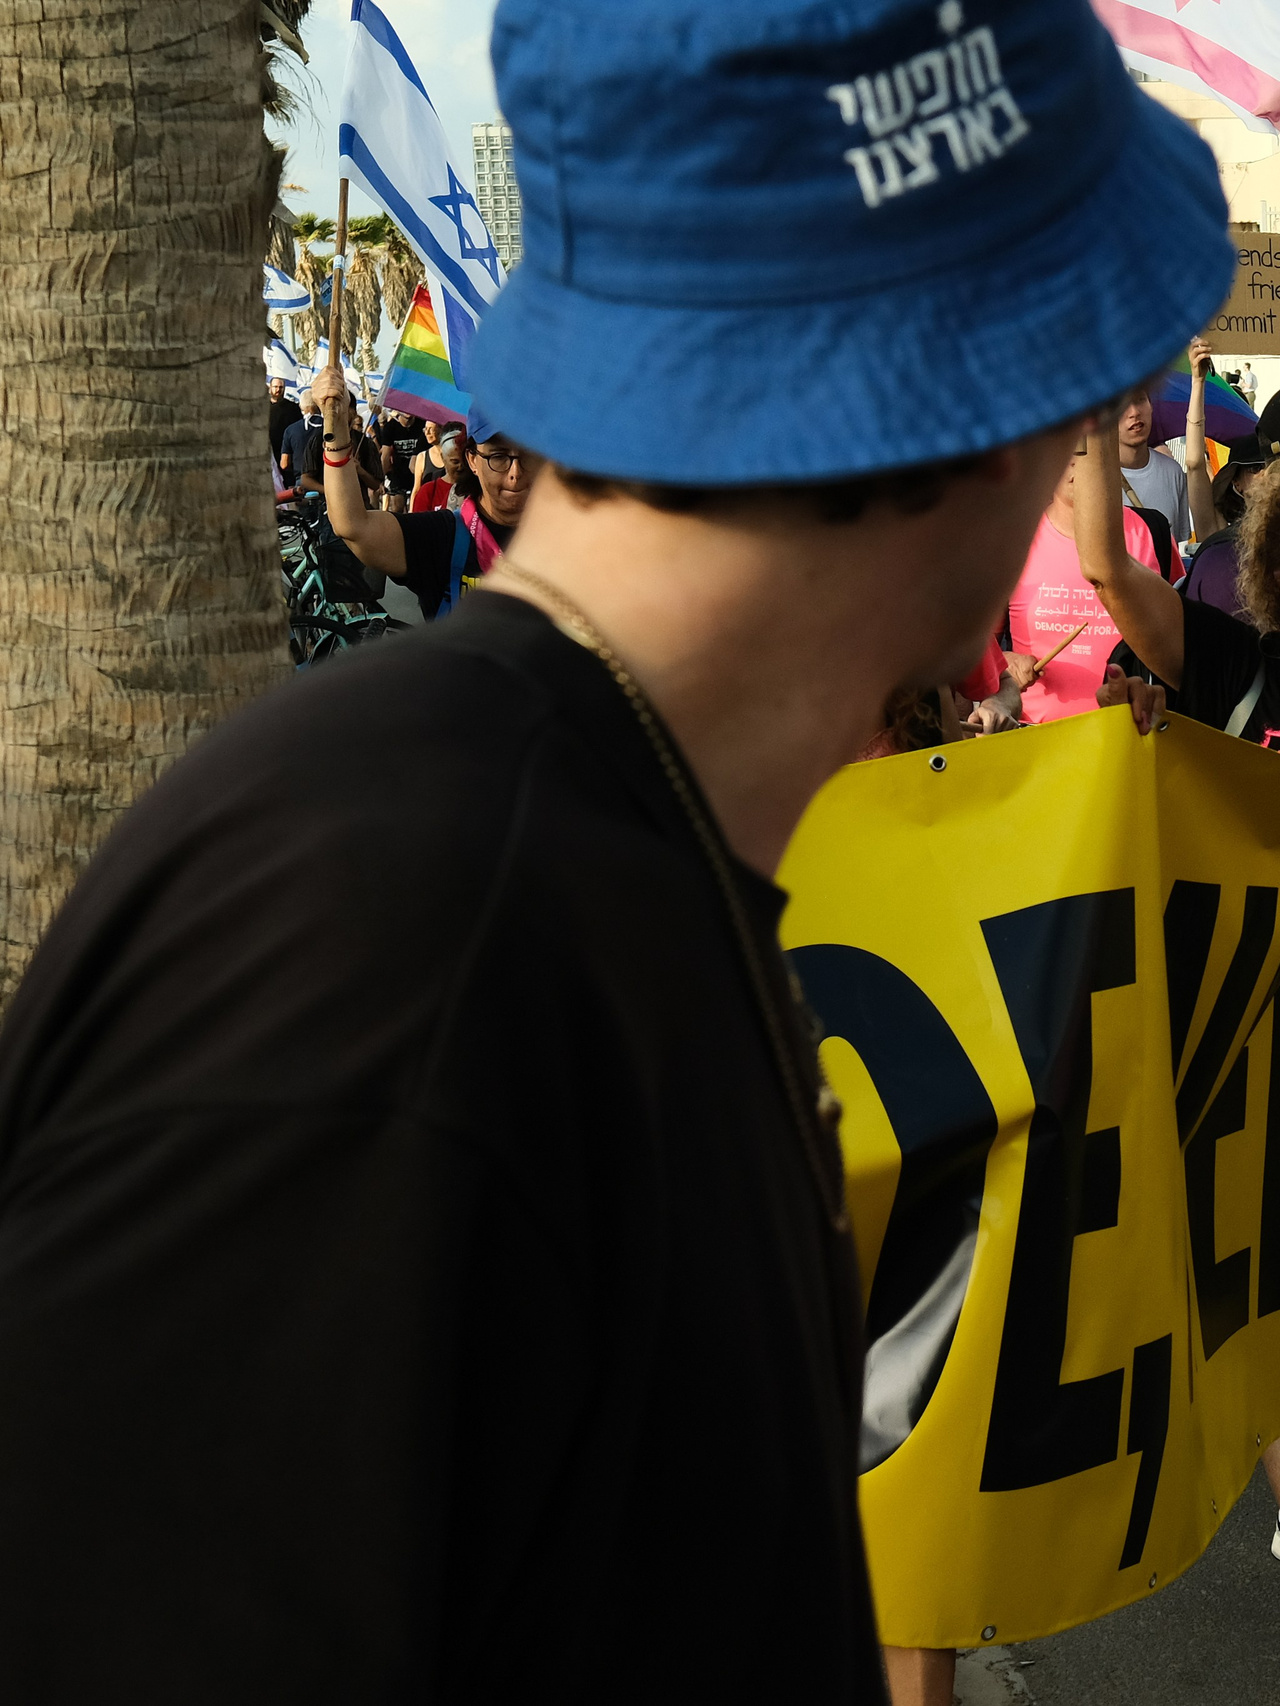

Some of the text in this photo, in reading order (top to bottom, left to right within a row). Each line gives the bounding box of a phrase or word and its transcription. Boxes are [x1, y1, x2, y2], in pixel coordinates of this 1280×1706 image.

[826, 24, 1003, 138] חופשי
[843, 87, 1030, 208] בארצנו
[1038, 582, 1069, 600] לכולן
[1094, 626, 1111, 635] FOR
